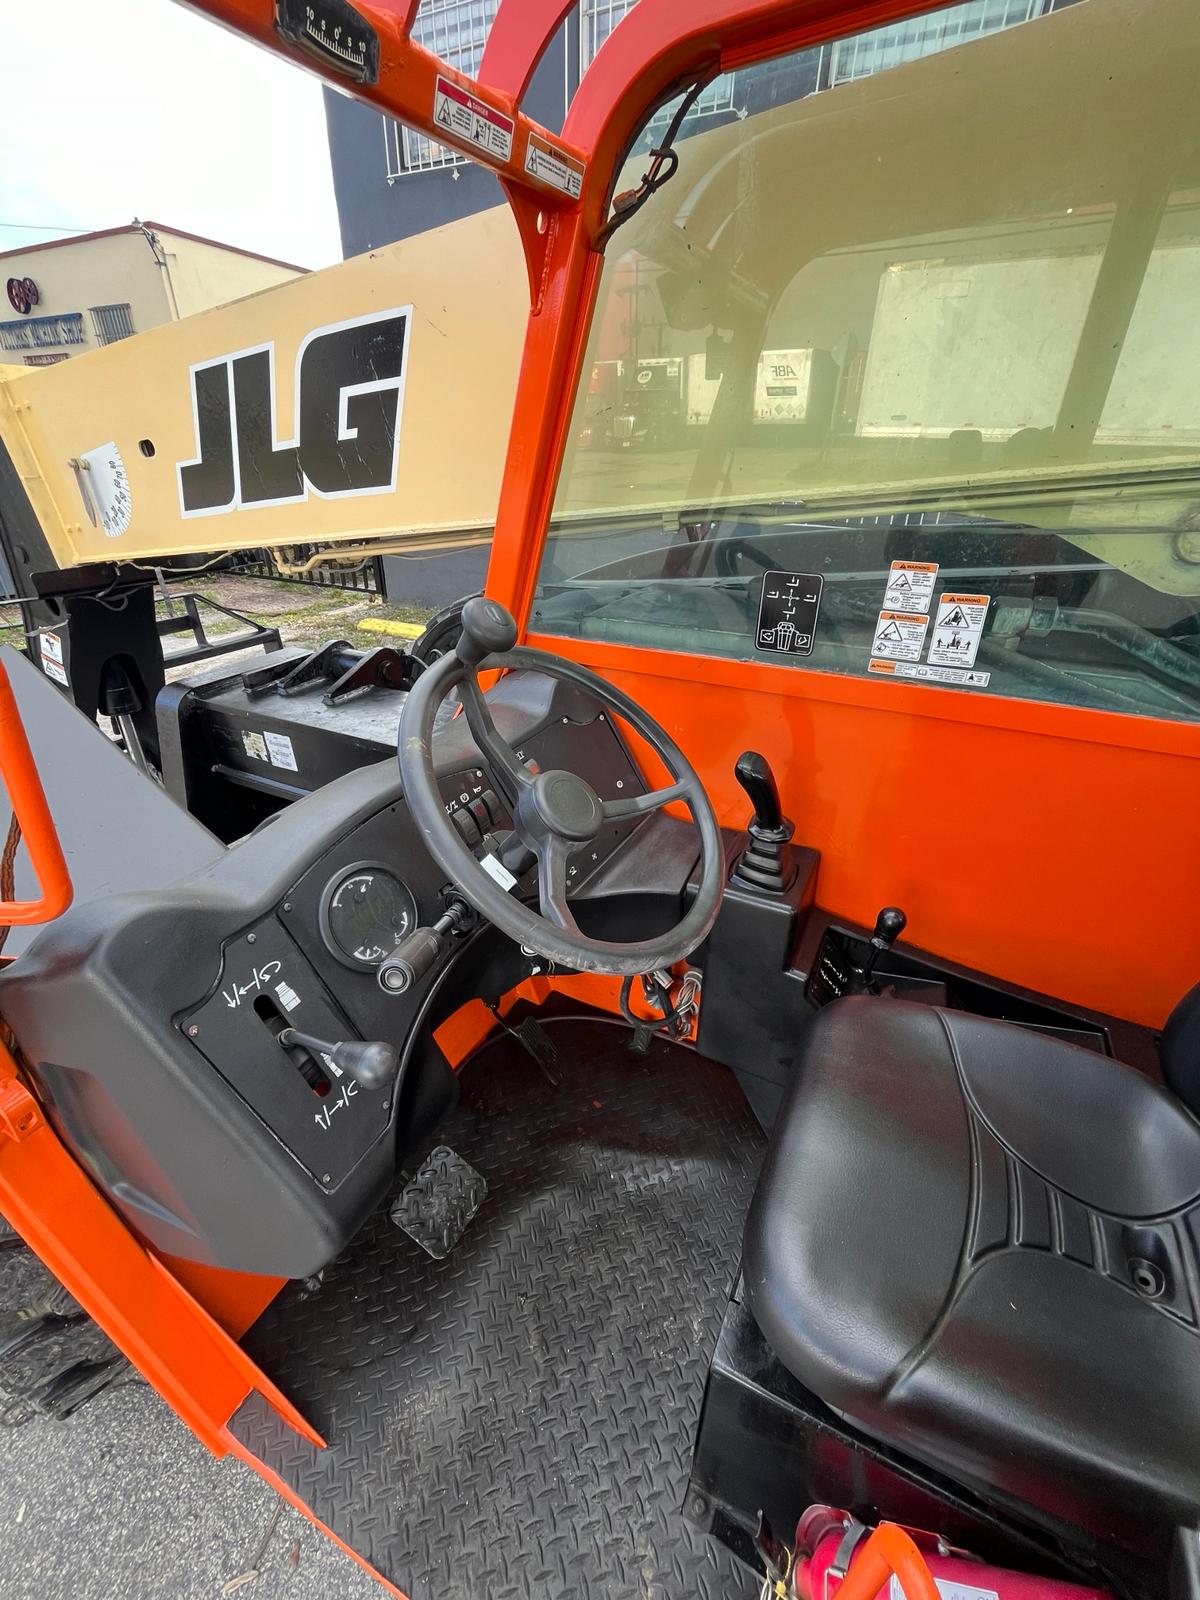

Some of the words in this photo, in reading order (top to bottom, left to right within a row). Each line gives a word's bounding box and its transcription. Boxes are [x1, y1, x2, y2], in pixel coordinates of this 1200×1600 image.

[305, 6, 315, 20] 10
[321, 20, 326, 31] 5
[347, 37, 352, 47] 5
[358, 40, 366, 53] 10
[176, 303, 414, 520] JLG
